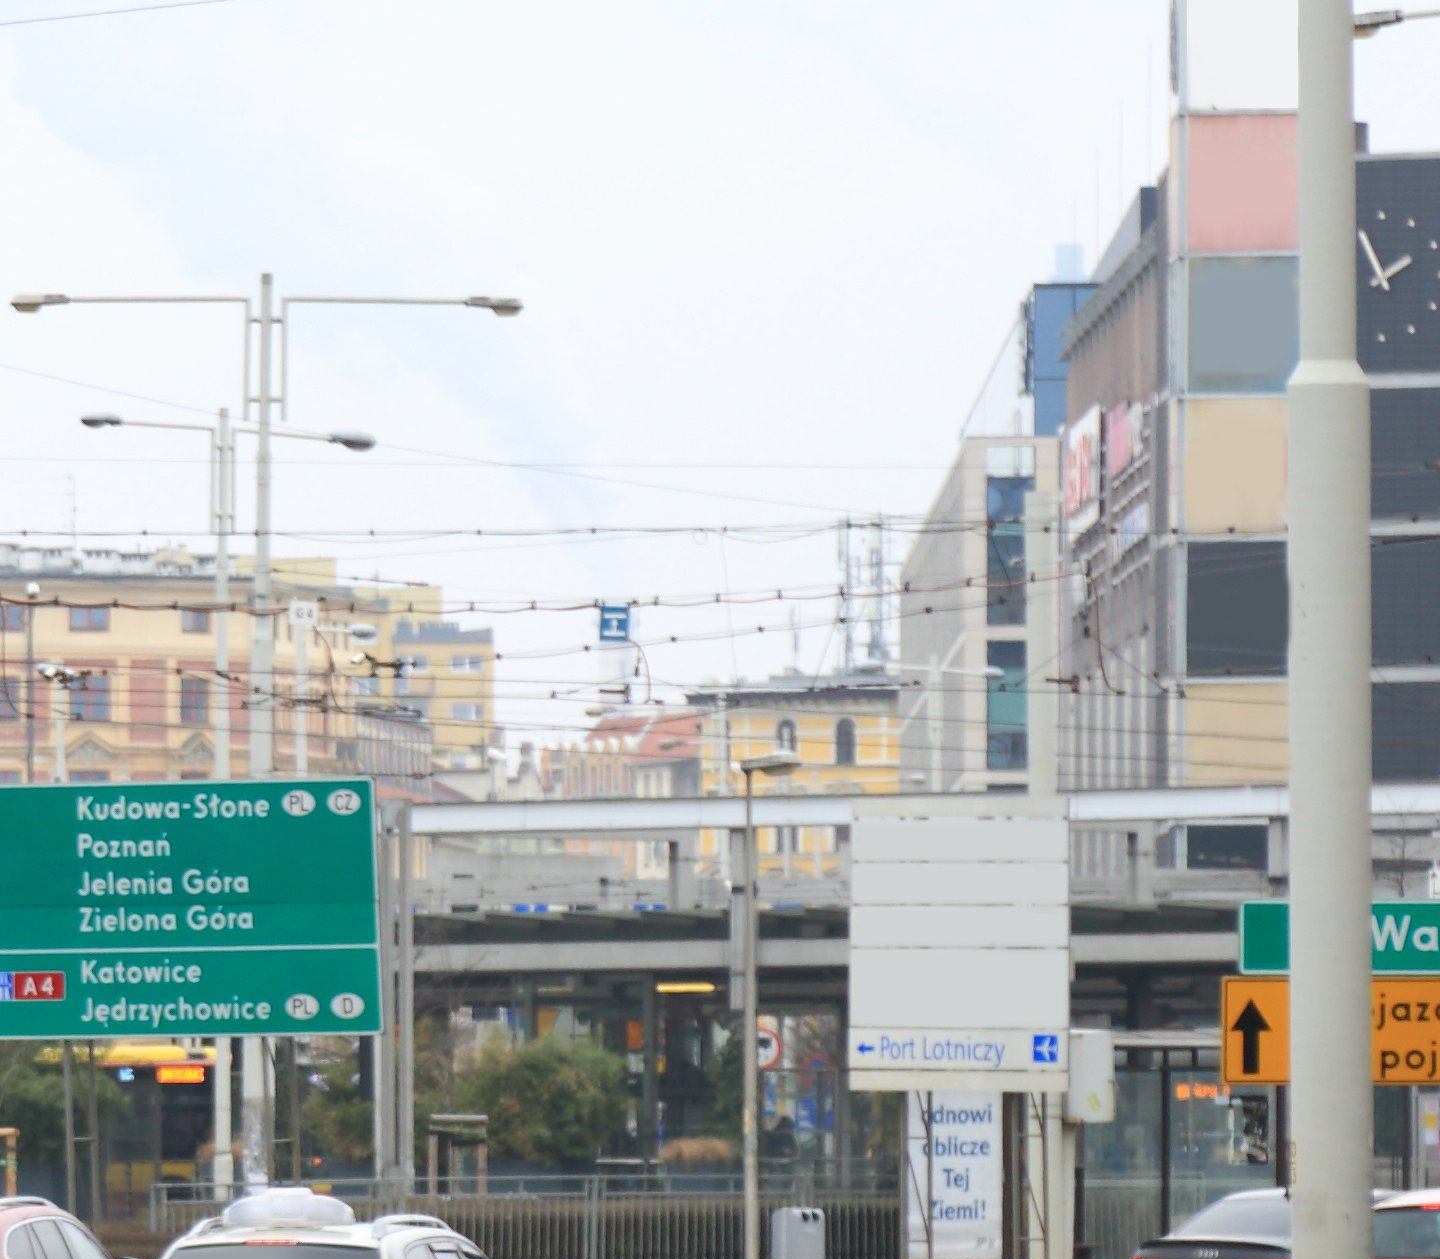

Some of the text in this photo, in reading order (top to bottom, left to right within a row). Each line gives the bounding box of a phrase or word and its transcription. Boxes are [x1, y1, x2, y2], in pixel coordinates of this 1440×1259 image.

[77, 793, 355, 821] Kudowa-Słone PL CZ
[77, 832, 171, 859] Poznań
[78, 868, 250, 896] Jelenia Góra
[79, 904, 254, 933] Zielona Góra
[81, 959, 202, 984] Katowice
[81, 995, 355, 1029] Jędrzychowice PL D
[878, 1034, 1005, 1067] Port Lotniczy
[942, 1168, 970, 1192] Tej
